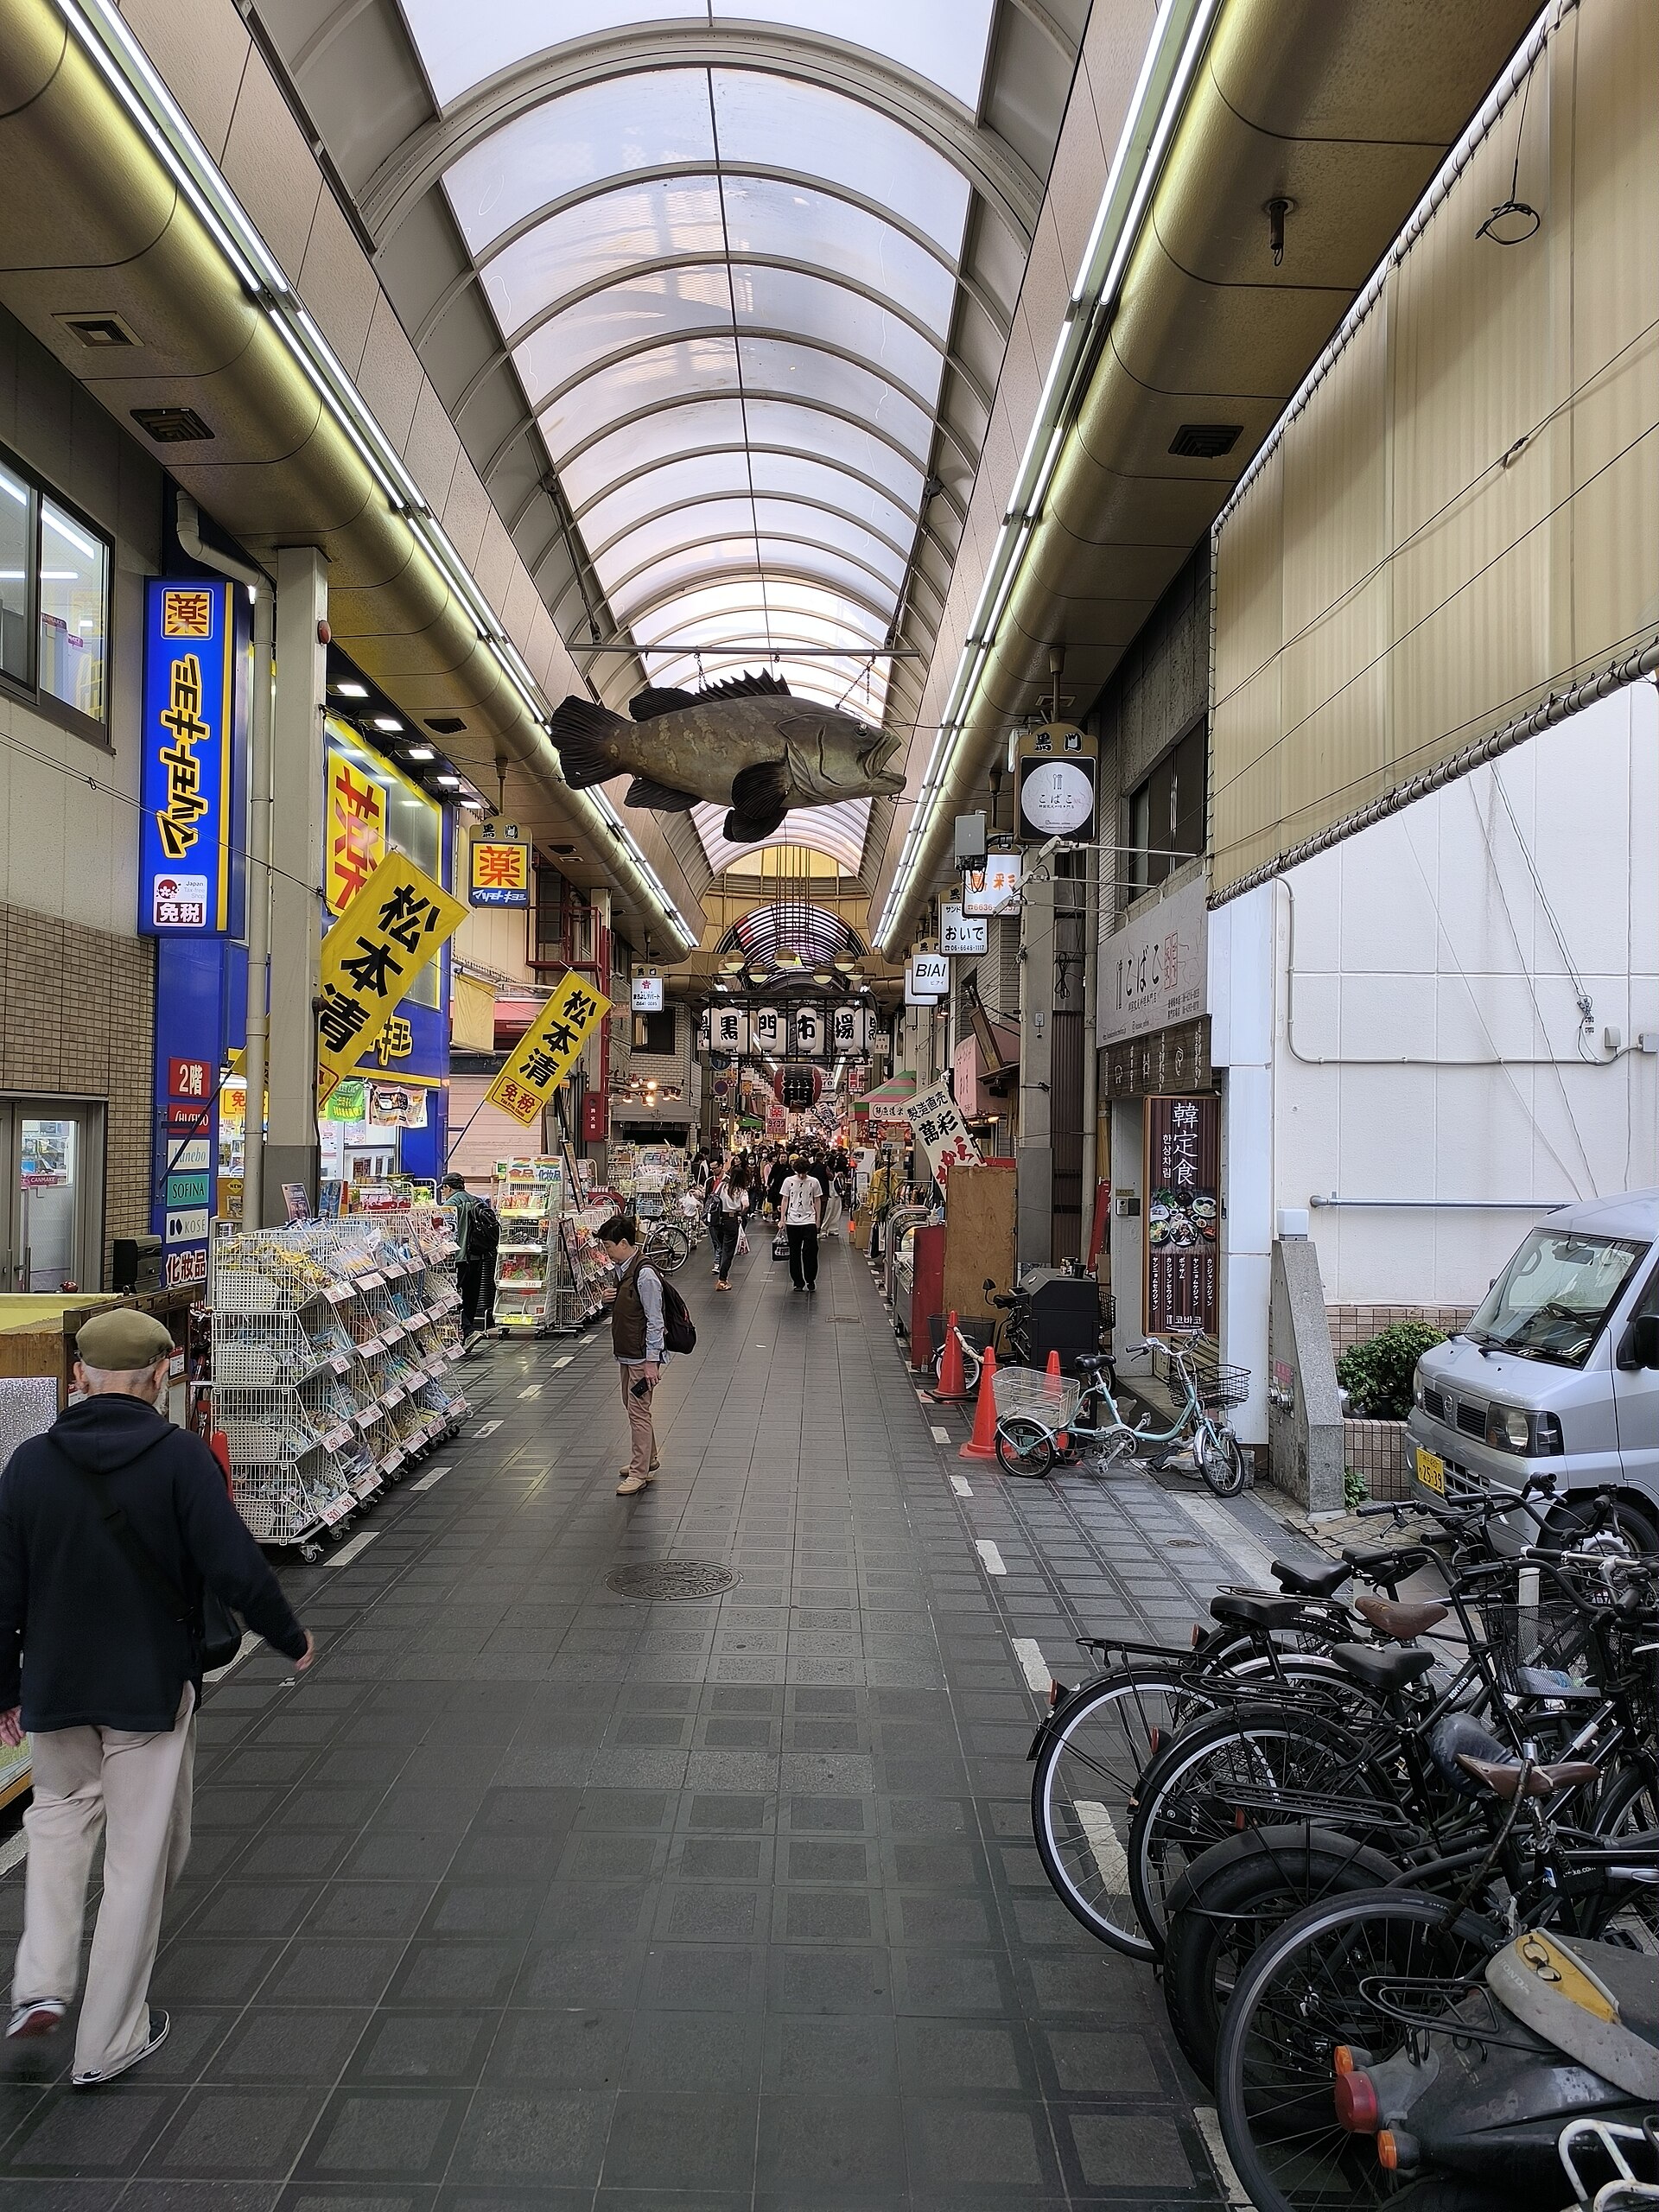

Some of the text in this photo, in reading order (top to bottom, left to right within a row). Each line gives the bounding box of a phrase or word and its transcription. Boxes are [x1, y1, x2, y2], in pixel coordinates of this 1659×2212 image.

[167, 593, 208, 634] 薬
[158, 654, 209, 856] マツモトキヨシ
[1034, 732, 1082, 753] 黒門
[1039, 793, 1073, 804] こばこ
[481, 823, 518, 839] 黒門
[479, 845, 520, 887] 薬
[472, 889, 527, 903] マツモトキヨシ
[159, 902, 200, 923] 免税
[944, 925, 985, 941] おいで
[318, 882, 442, 1054] 松本清
[916, 963, 946, 977] BIAI
[518, 989, 598, 1089] 松本清
[178, 1064, 204, 1096] 2階
[500, 1083, 537, 1115] 免税
[906, 1090, 949, 1122] 製造直売
[918, 1109, 959, 1147] 萬彩
[1161, 1133, 1173, 1179] 한상차림
[1171, 1102, 1200, 1186] 韓定食
[172, 1181, 205, 1199] SOFINA
[184, 1216, 206, 1234] KOSÉ
[1174, 1315, 1203, 1325] 코바코
[1422, 1464, 1442, 1490] 25-39
[327, 1497, 355, 1522] 500 500
